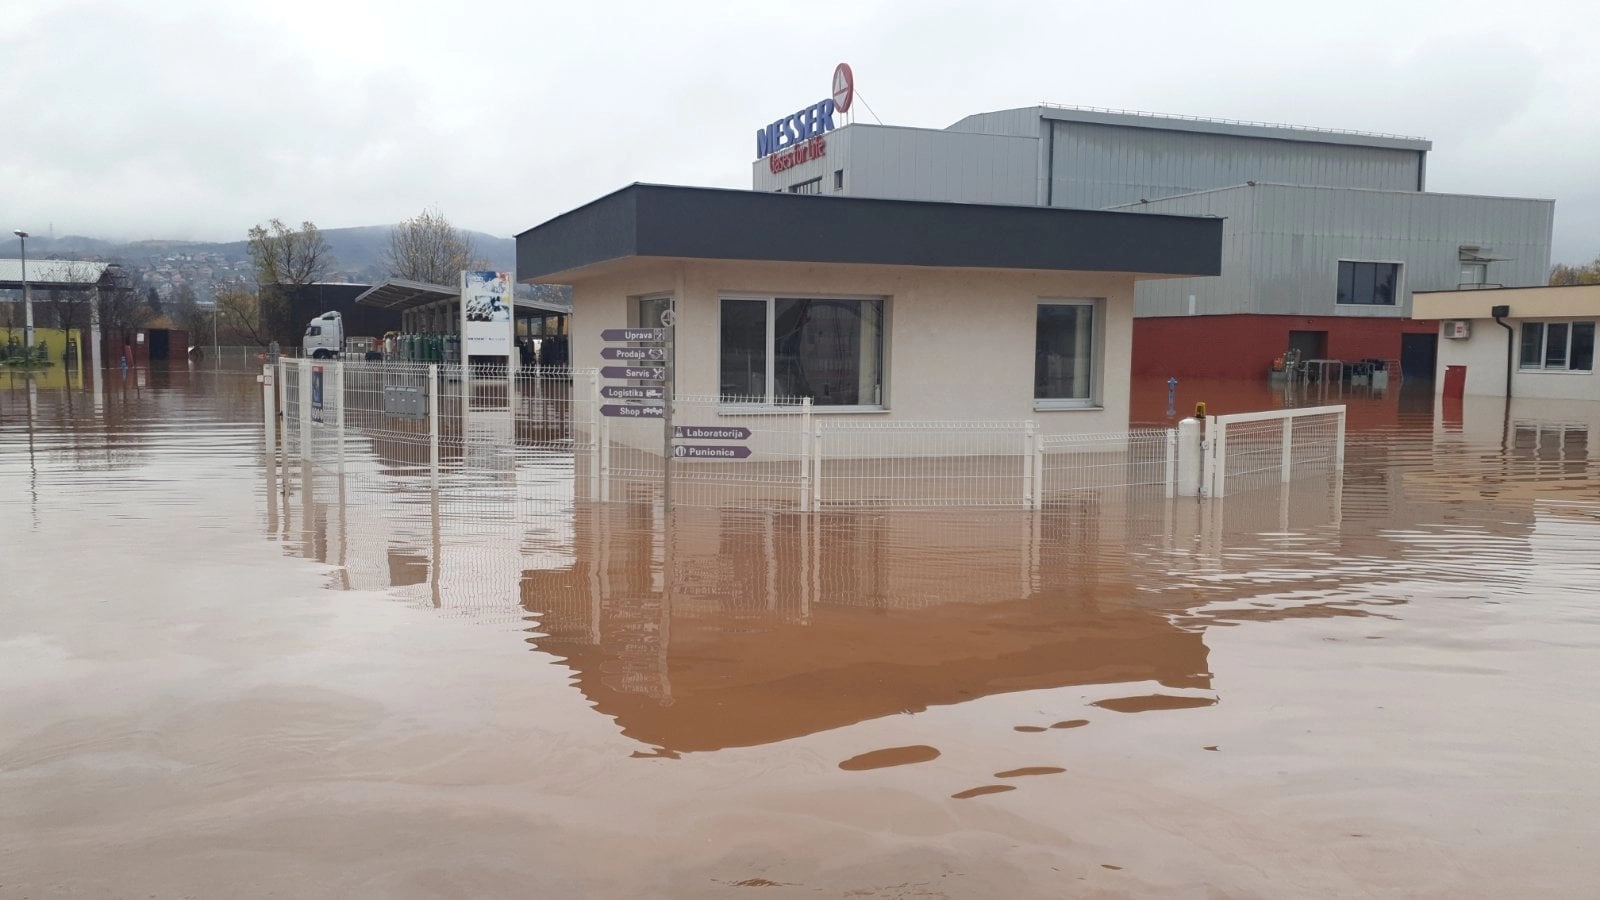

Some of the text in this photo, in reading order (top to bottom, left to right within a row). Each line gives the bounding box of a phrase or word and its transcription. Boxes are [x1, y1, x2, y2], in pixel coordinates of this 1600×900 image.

[757, 98, 834, 159] MESSER
[625, 331, 652, 340] Uprava
[616, 350, 645, 360] Prodaja
[626, 369, 649, 377] Servis
[609, 388, 643, 397] Logistika
[620, 407, 640, 416] Shop
[687, 428, 743, 439] Laboratorija
[689, 447, 735, 456] Punionica
